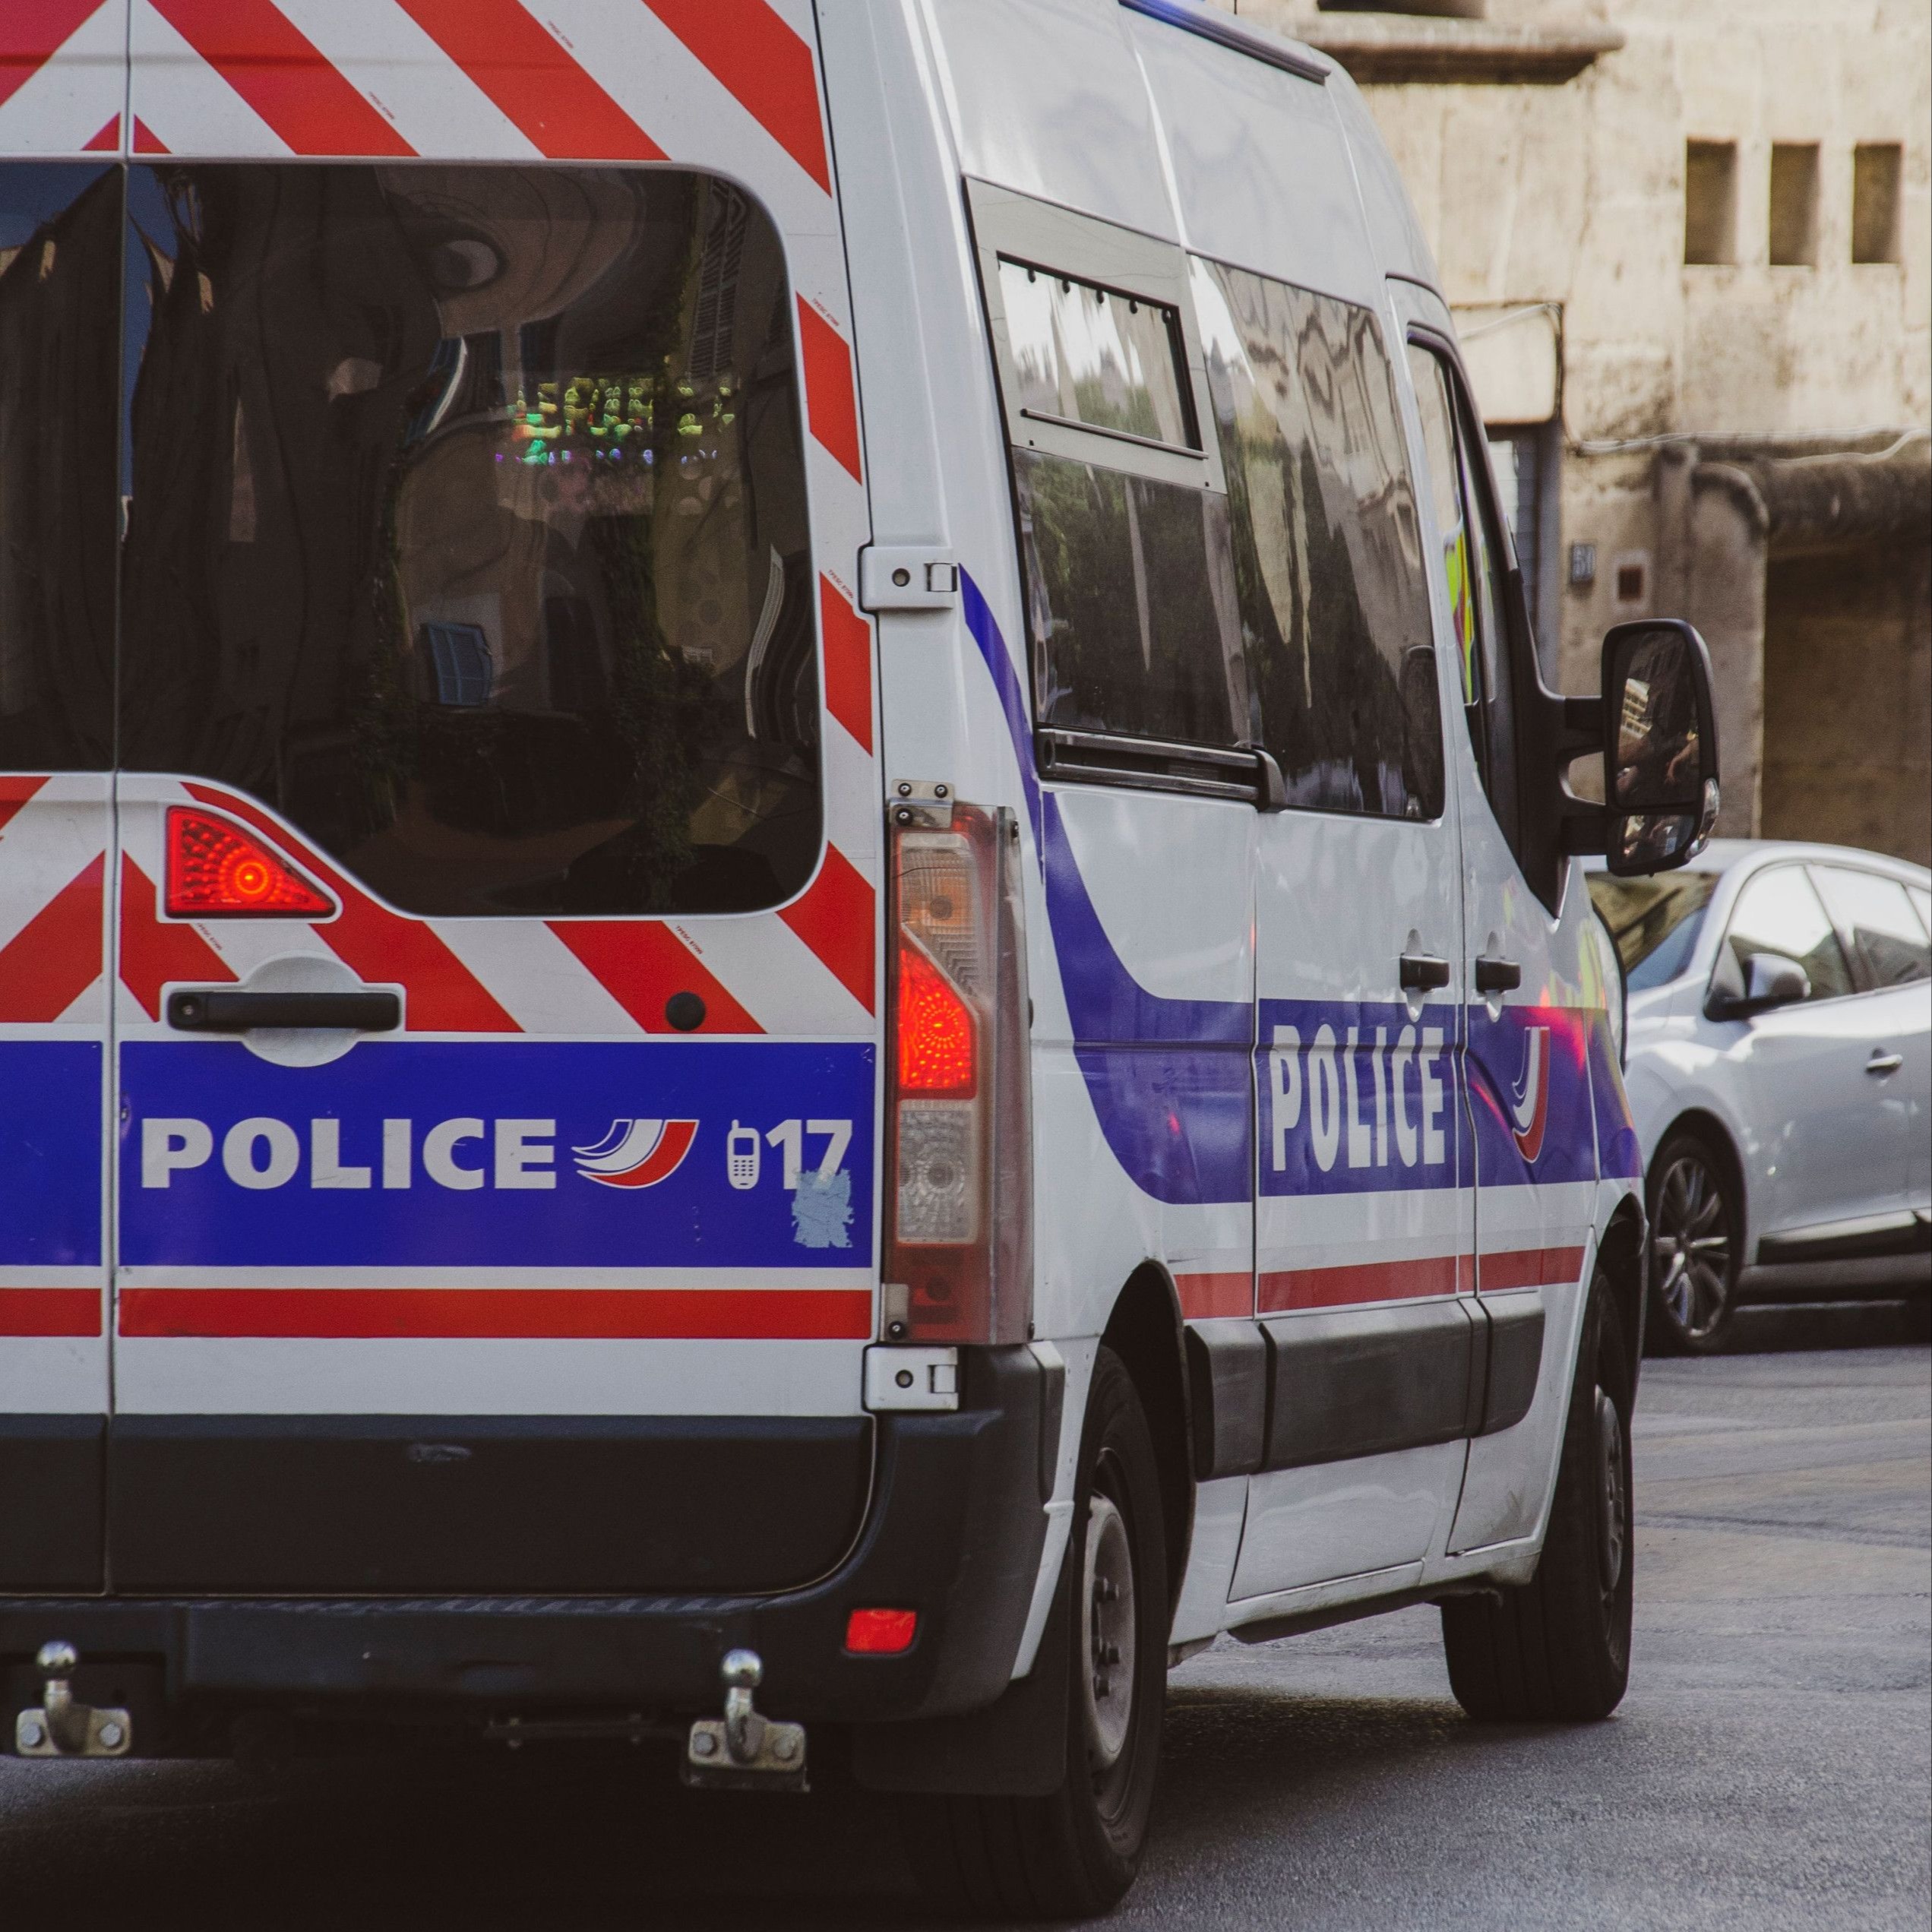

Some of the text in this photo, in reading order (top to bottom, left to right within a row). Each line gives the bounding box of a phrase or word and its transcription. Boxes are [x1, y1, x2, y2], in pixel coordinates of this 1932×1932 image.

[1269, 1023, 1445, 1172] POLICE
[141, 1117, 853, 1191] POLICE 17
